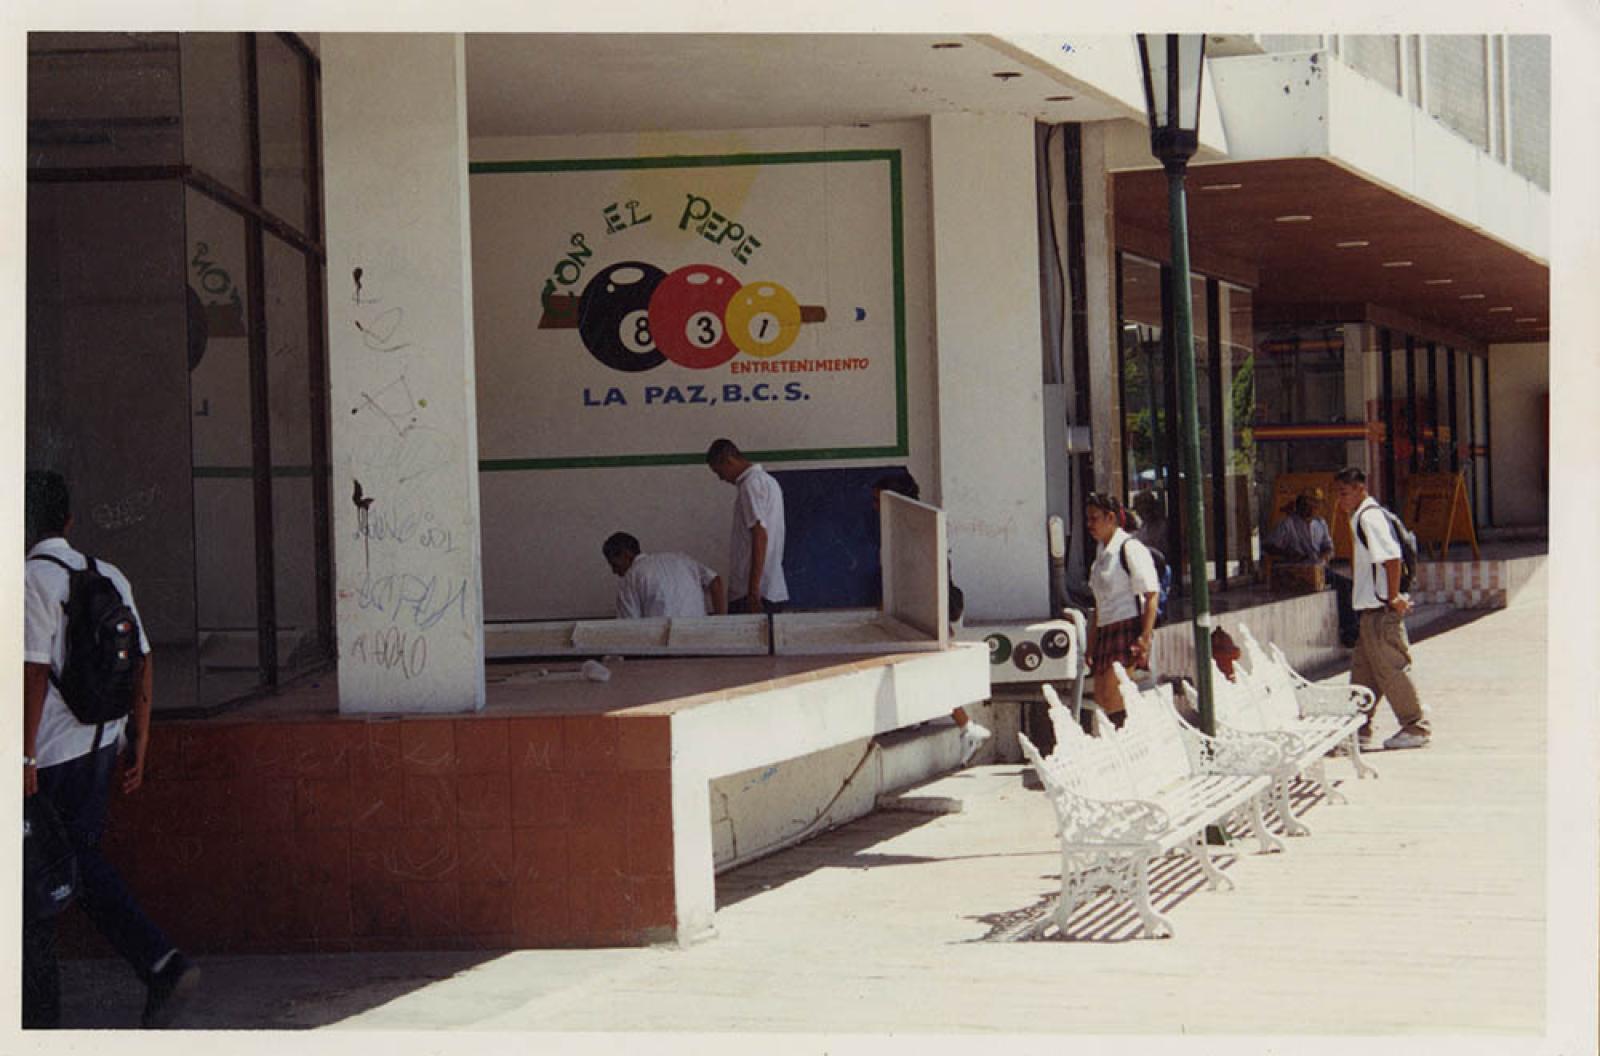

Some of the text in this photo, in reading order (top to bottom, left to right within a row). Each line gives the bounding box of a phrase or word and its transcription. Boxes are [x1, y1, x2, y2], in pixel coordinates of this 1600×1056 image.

[603, 201, 652, 234] EL
[678, 193, 762, 265] PEPE
[634, 317, 769, 346] 8 3 1
[730, 358, 870, 374] ENTRETENIMIENTO
[583, 381, 811, 407] LA PAZ, B.C.S.
